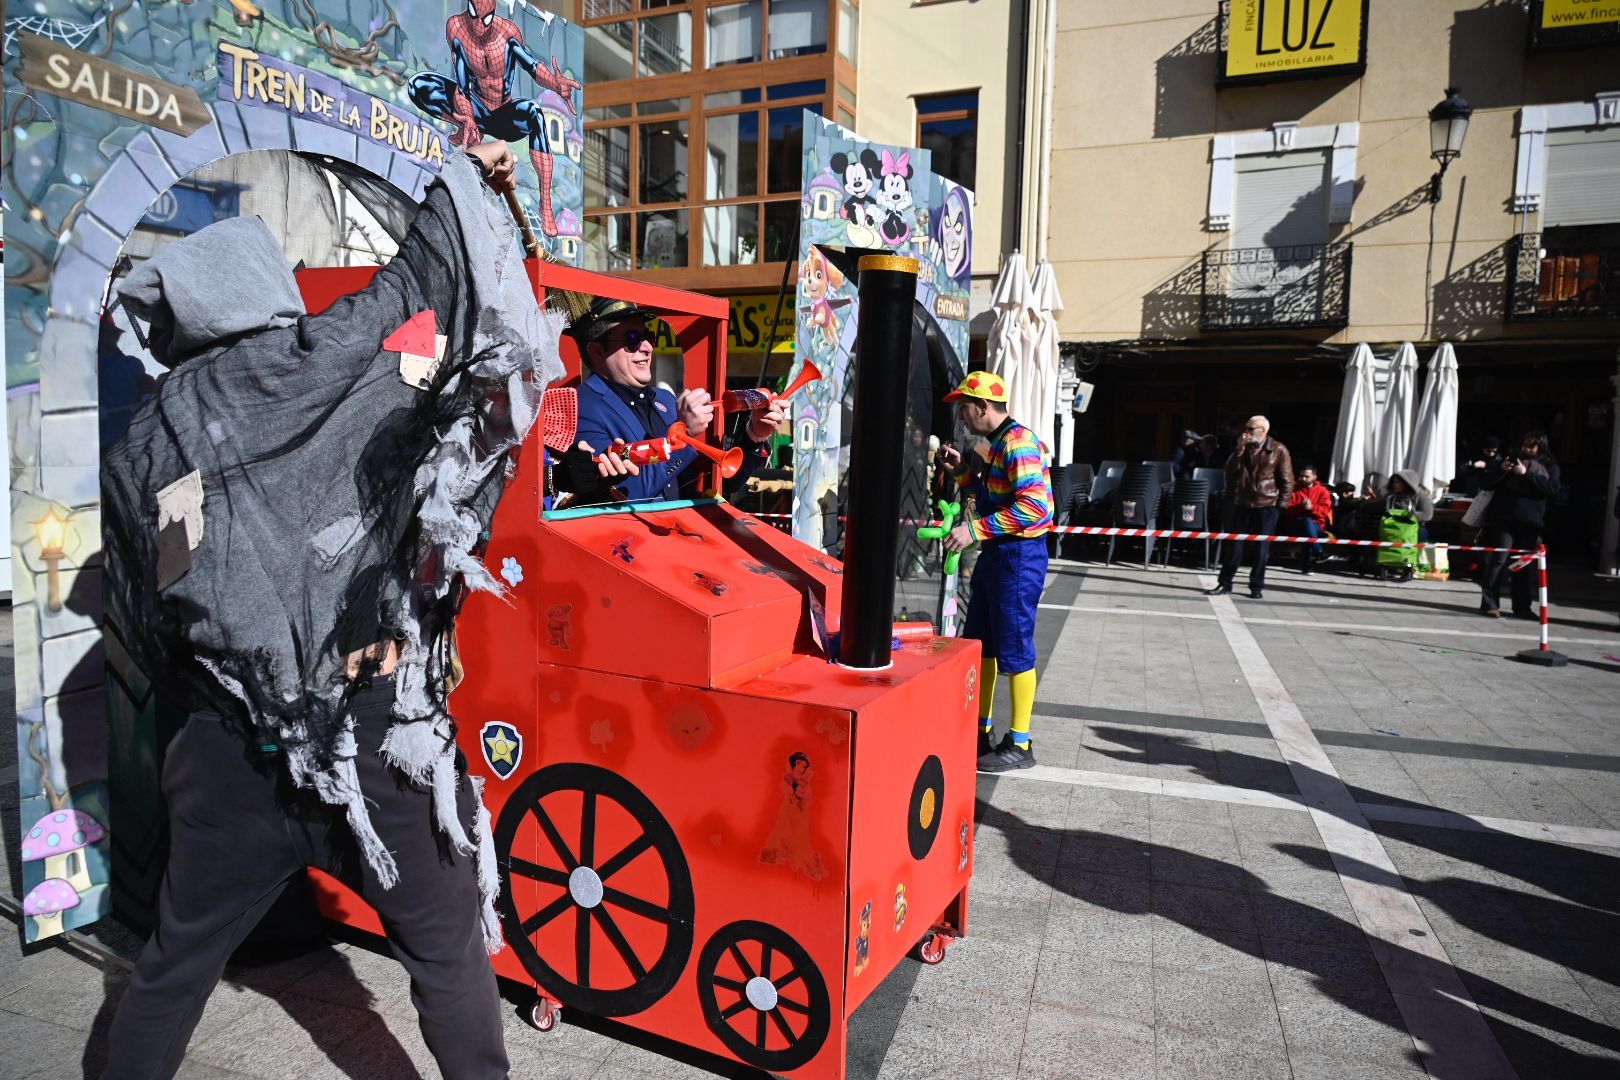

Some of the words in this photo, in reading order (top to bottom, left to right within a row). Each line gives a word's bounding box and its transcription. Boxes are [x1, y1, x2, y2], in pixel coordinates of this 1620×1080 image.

[1256, 0, 1335, 55] LUZ
[1255, 54, 1334, 68] INMOBILIARIA
[45, 54, 183, 127] SALIDA
[219, 42, 305, 113] TREN
[309, 88, 335, 117] DE
[339, 100, 361, 129] LA
[370, 97, 443, 167] BRUJA
[937, 299, 964, 317] ENTRADA
